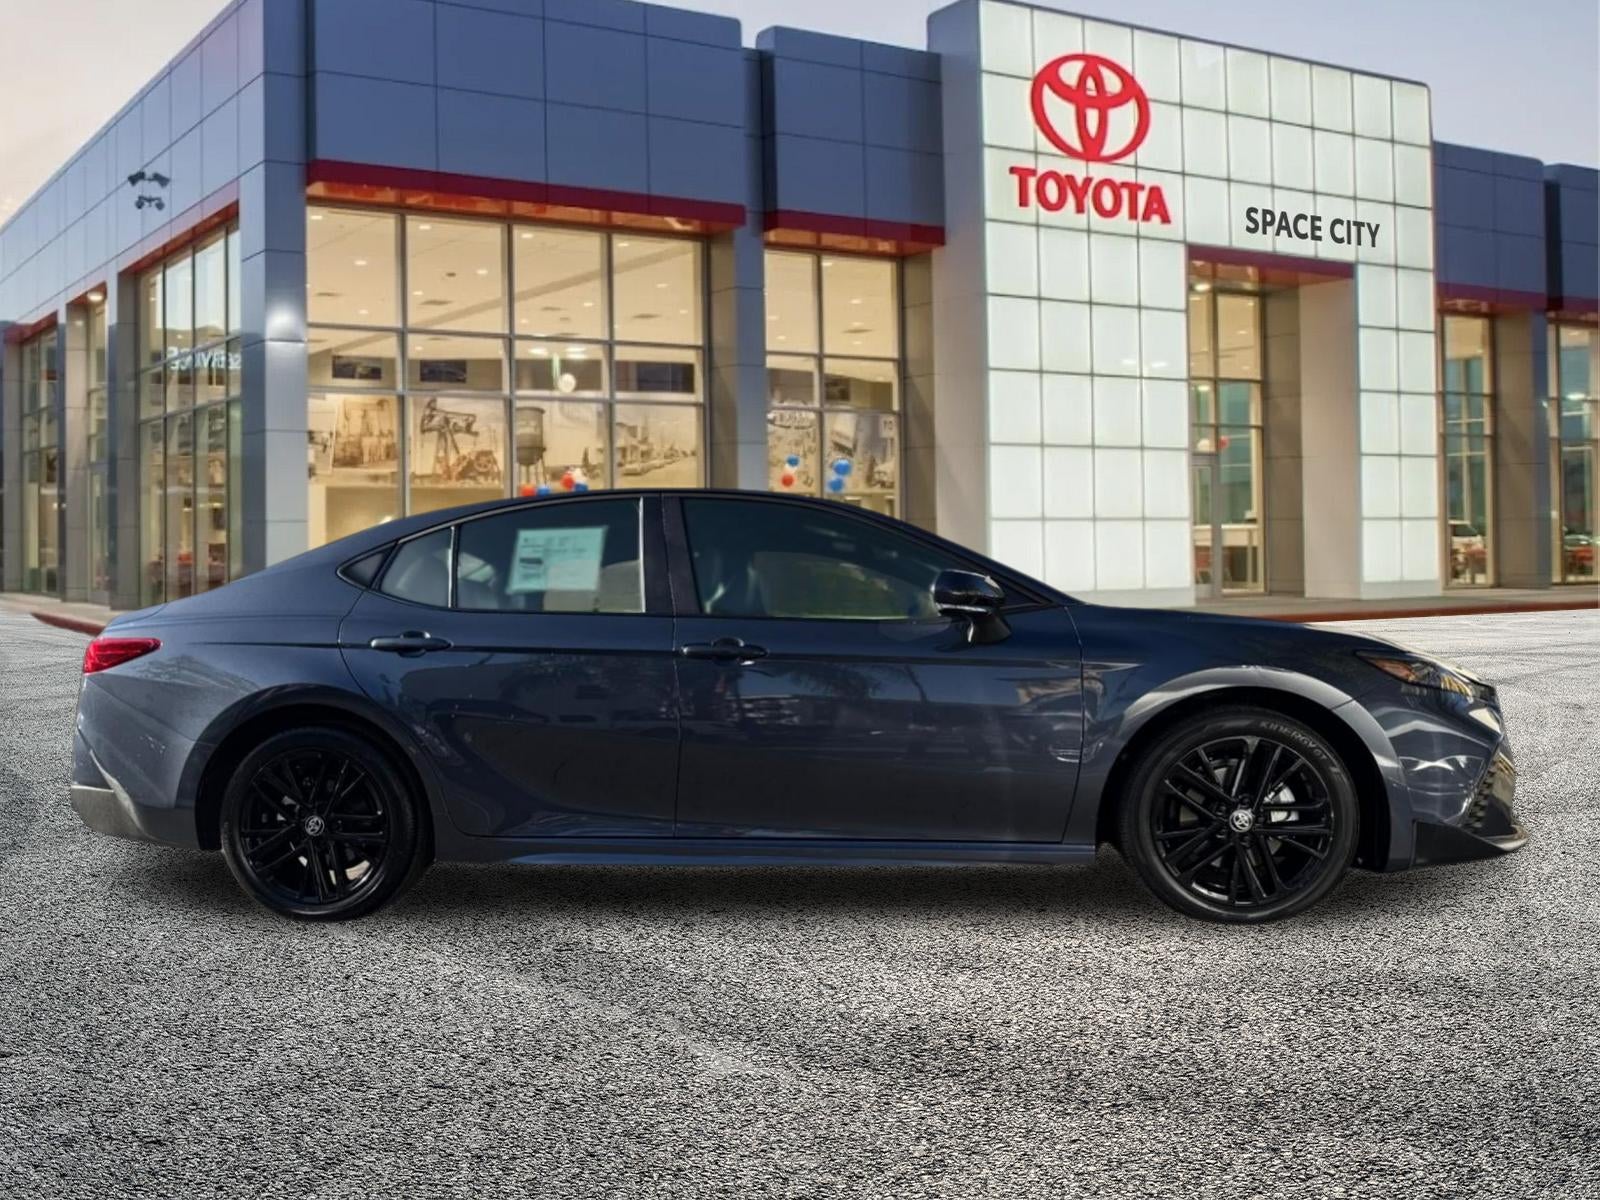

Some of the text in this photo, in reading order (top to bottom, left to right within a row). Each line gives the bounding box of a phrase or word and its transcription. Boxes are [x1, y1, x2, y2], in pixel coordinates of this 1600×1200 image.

[1009, 166, 1171, 224] TOYOTA
[1245, 206, 1380, 248] SPACE CITY
